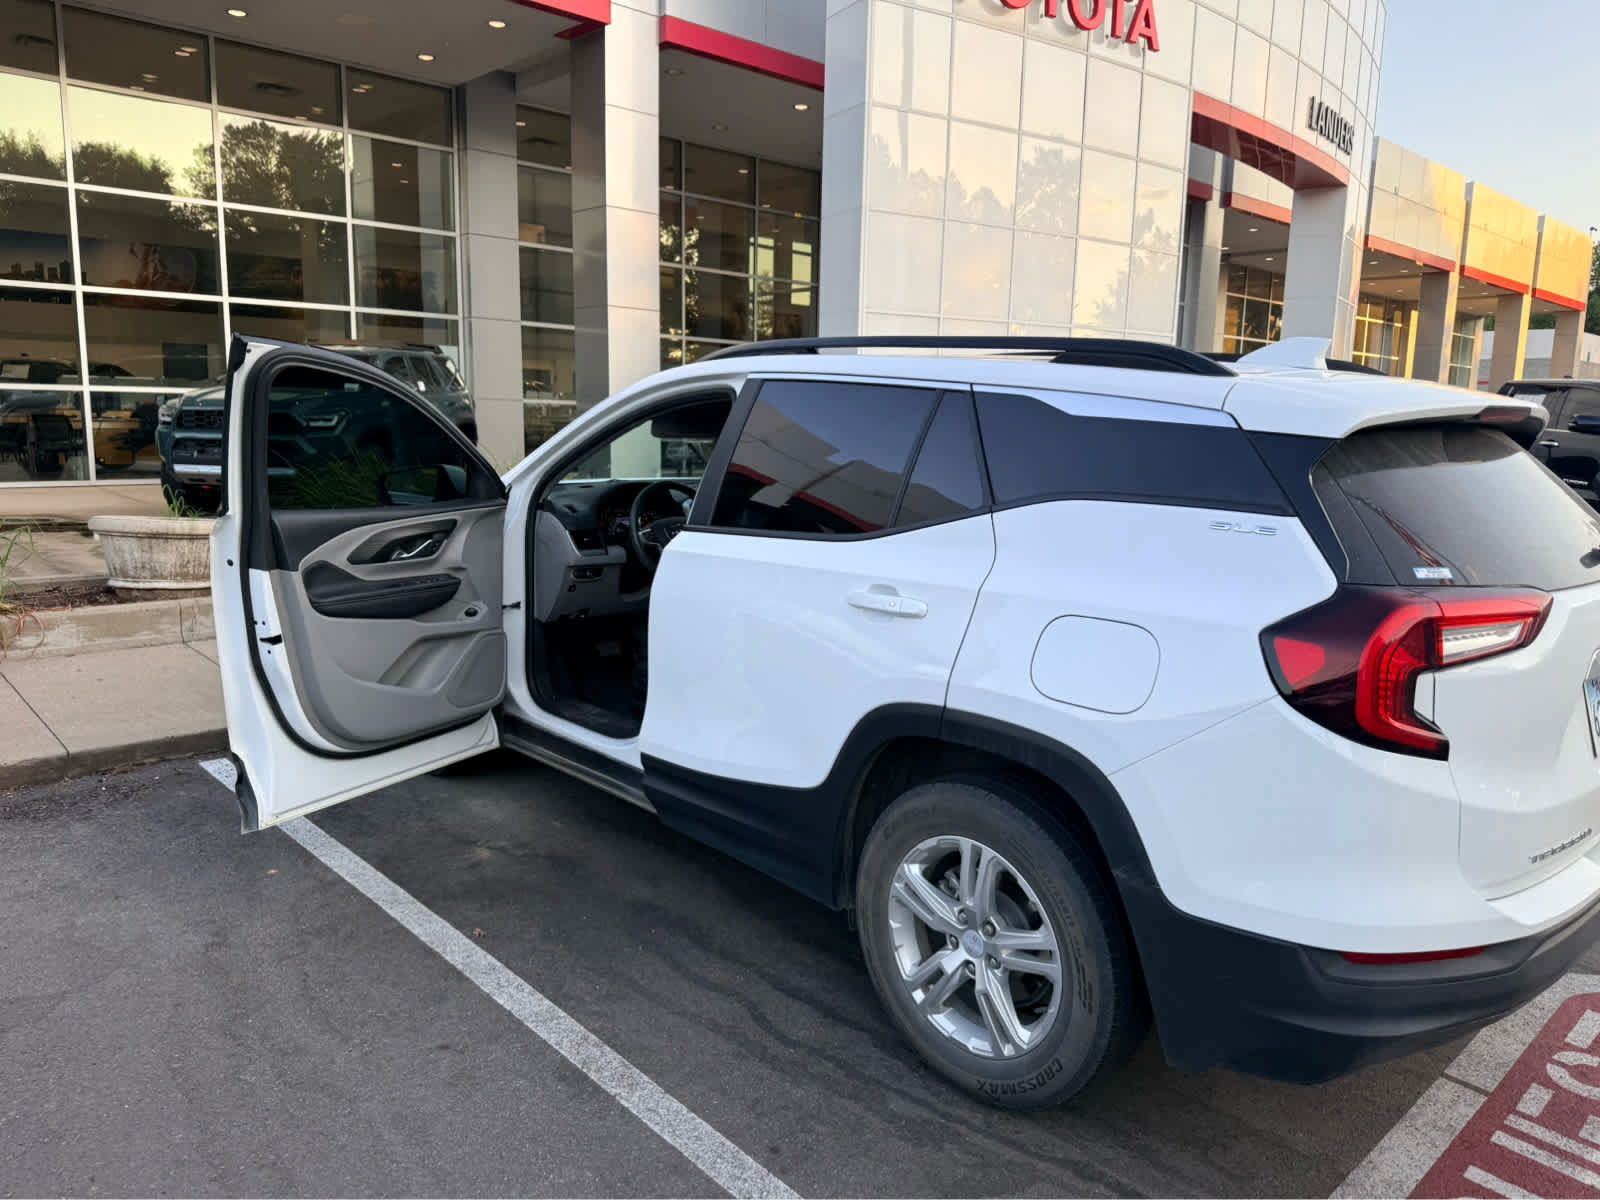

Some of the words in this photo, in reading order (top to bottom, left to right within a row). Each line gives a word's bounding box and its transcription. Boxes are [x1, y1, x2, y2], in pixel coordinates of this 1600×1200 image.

[1001, 0, 1160, 52] OTA
[1308, 95, 1354, 155] LANDERS
[976, 1058, 1063, 1097] CROSSMAX
